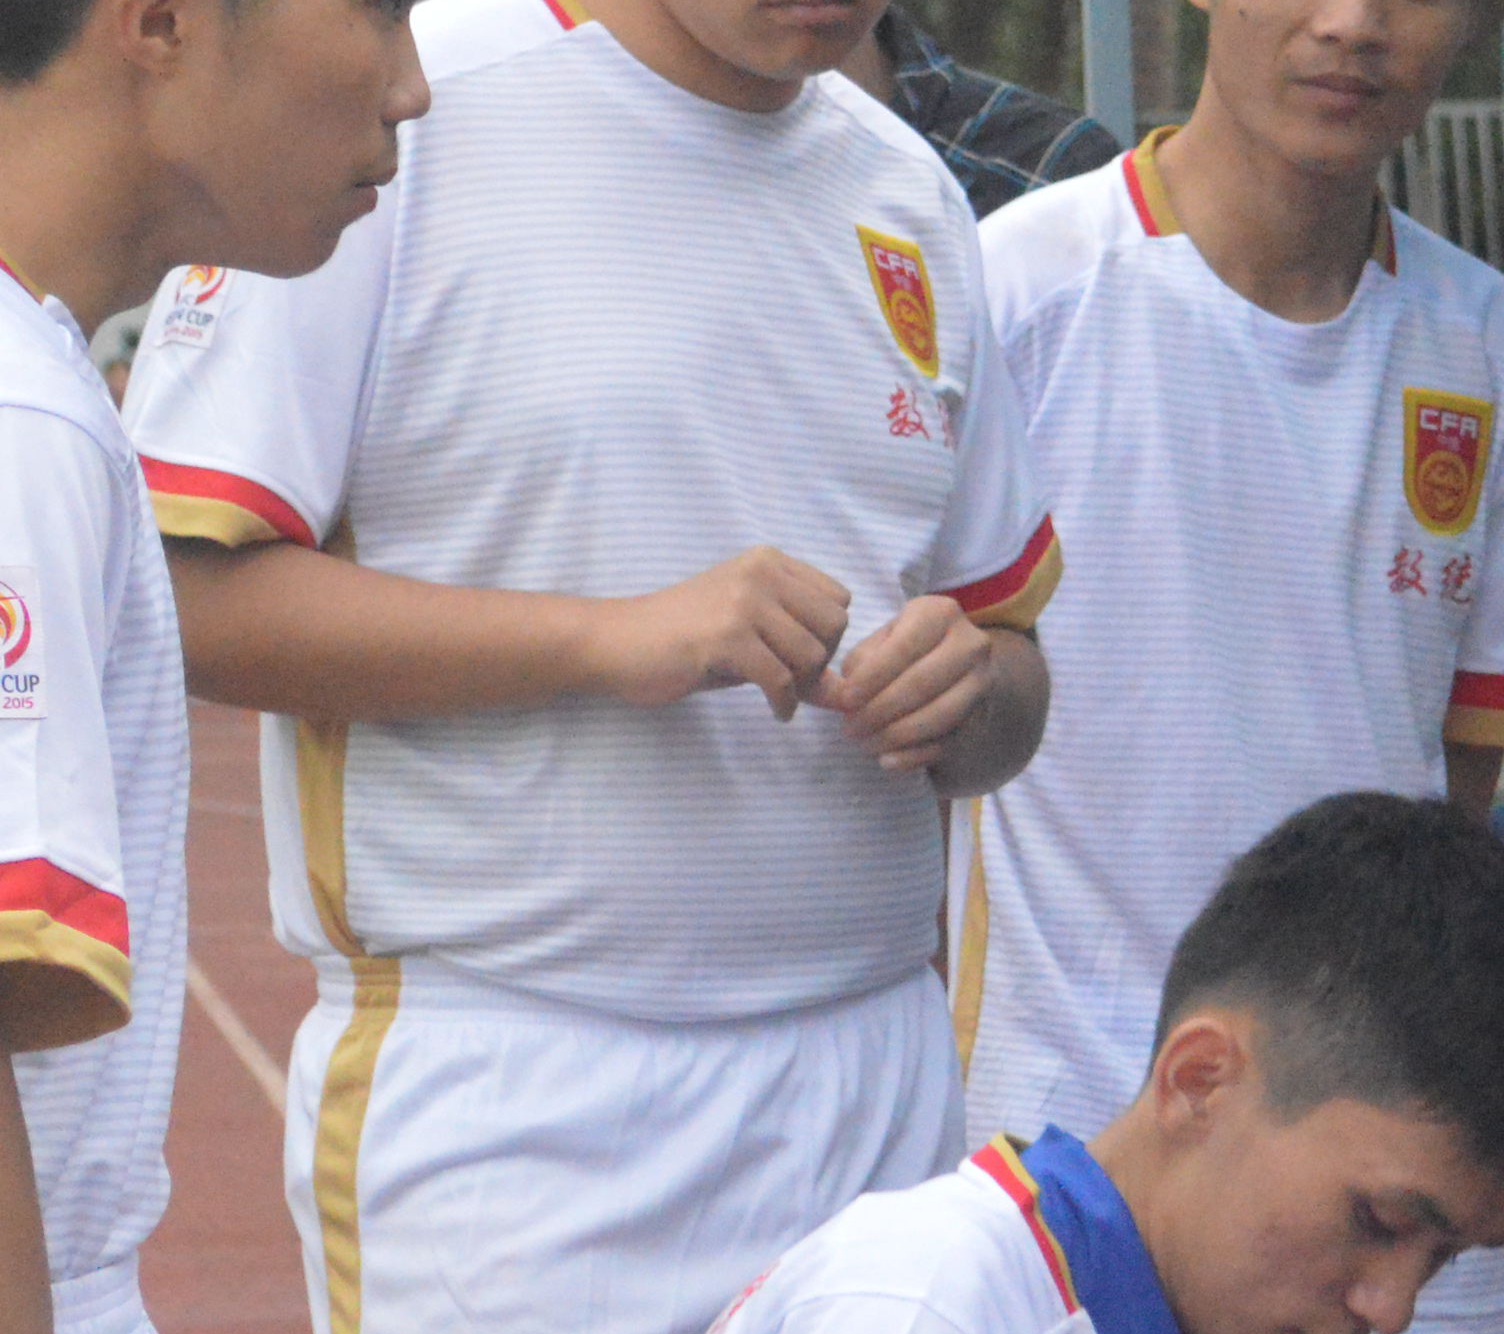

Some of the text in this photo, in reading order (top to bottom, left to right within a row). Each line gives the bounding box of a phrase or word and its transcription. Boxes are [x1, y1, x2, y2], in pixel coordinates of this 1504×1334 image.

[872, 246, 920, 280] CFA
[1420, 407, 1479, 439] CFA
[1, 674, 40, 694] CUP
[2, 696, 34, 710] 2015
